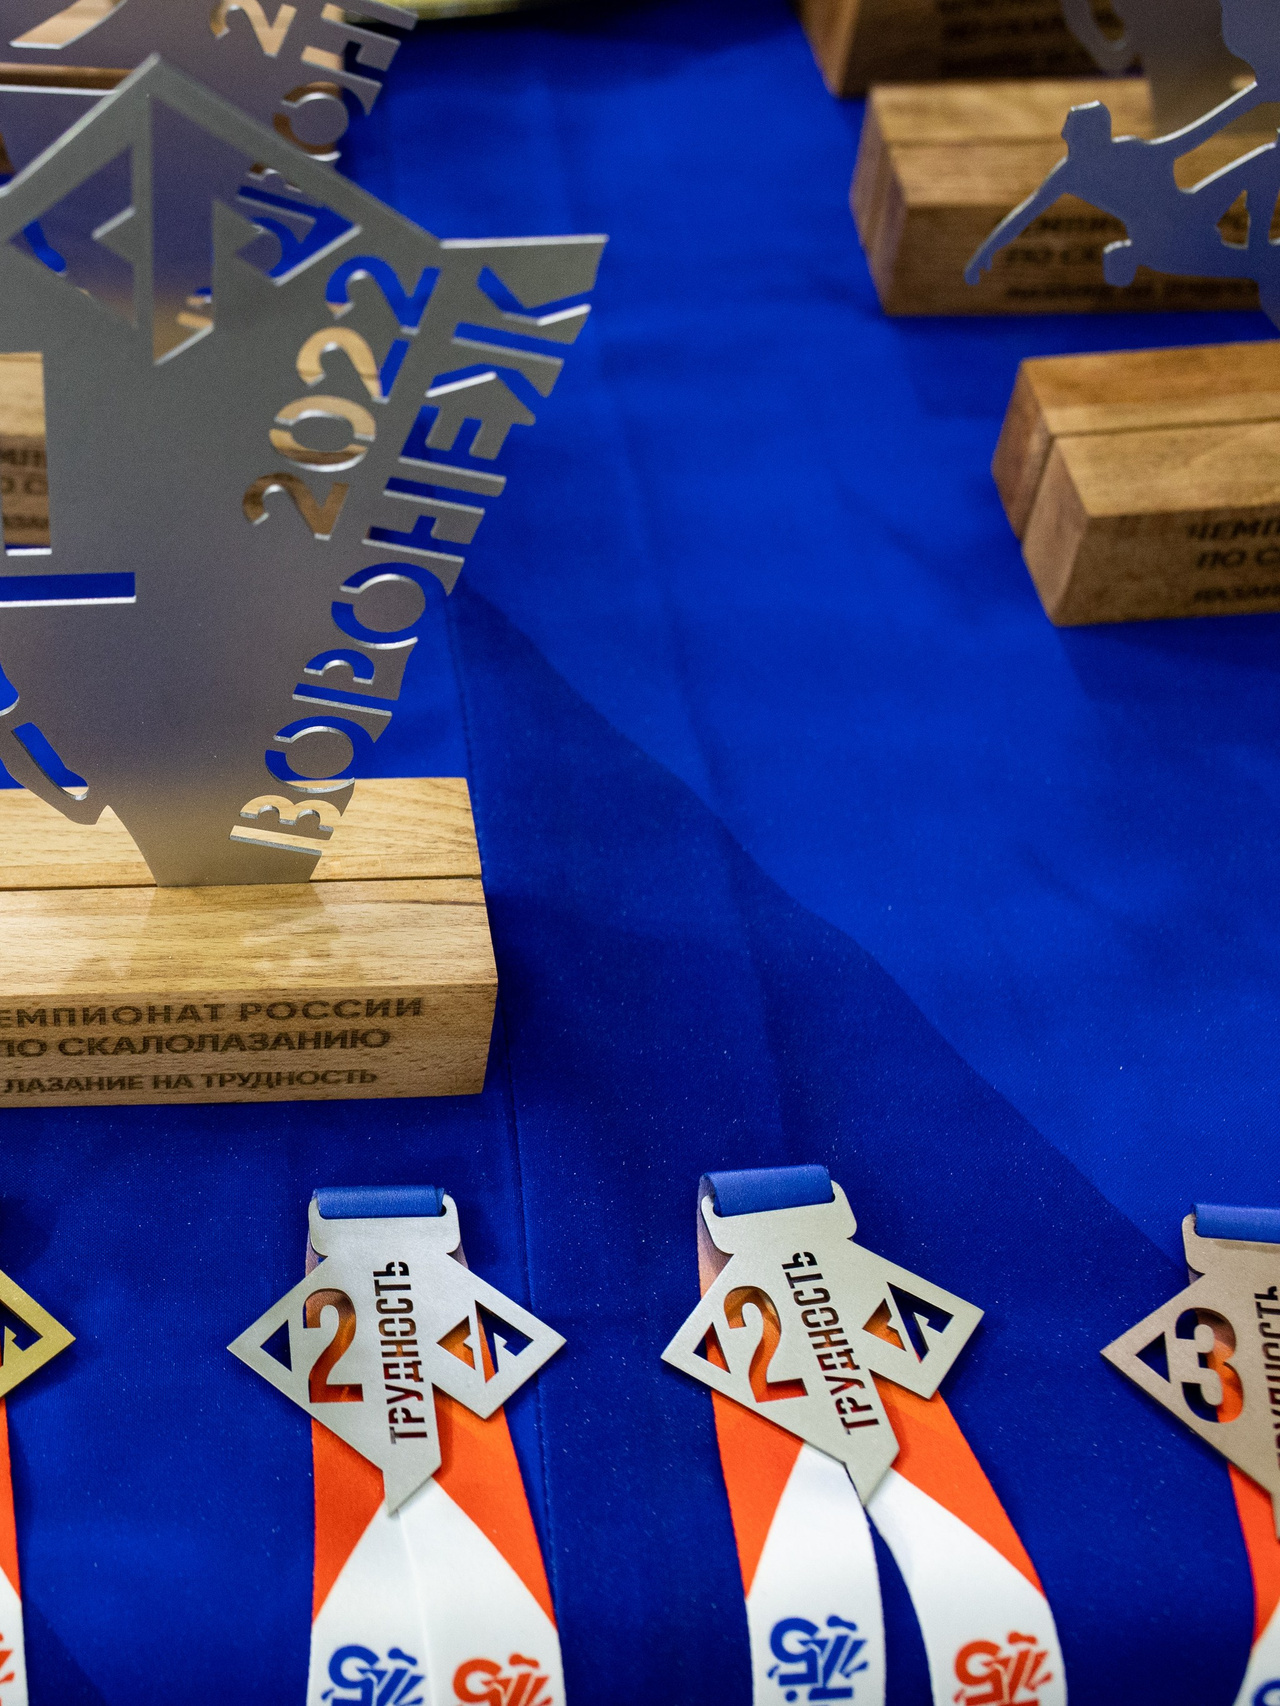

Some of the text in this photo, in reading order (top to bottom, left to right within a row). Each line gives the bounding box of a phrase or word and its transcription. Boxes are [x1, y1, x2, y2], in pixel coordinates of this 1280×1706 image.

[242, 254, 442, 541] 2022
[229, 266, 598, 856] ВОРОНЕЖ
[57, 1028, 393, 1058] СКАЛОЛАЗАНИЮ
[239, 996, 424, 1022] РОССИИ
[3, 1067, 379, 1094] ЛАЗАНИЕ НА ТРУДНОСТЬ
[302, 1287, 364, 1404] 2
[372, 1260, 429, 1446] ТРУДНОСТЬ
[722, 1285, 809, 1404] 2
[781, 1250, 881, 1436] ТРУДНОСТЬ
[1174, 1306, 1245, 1424] 3
